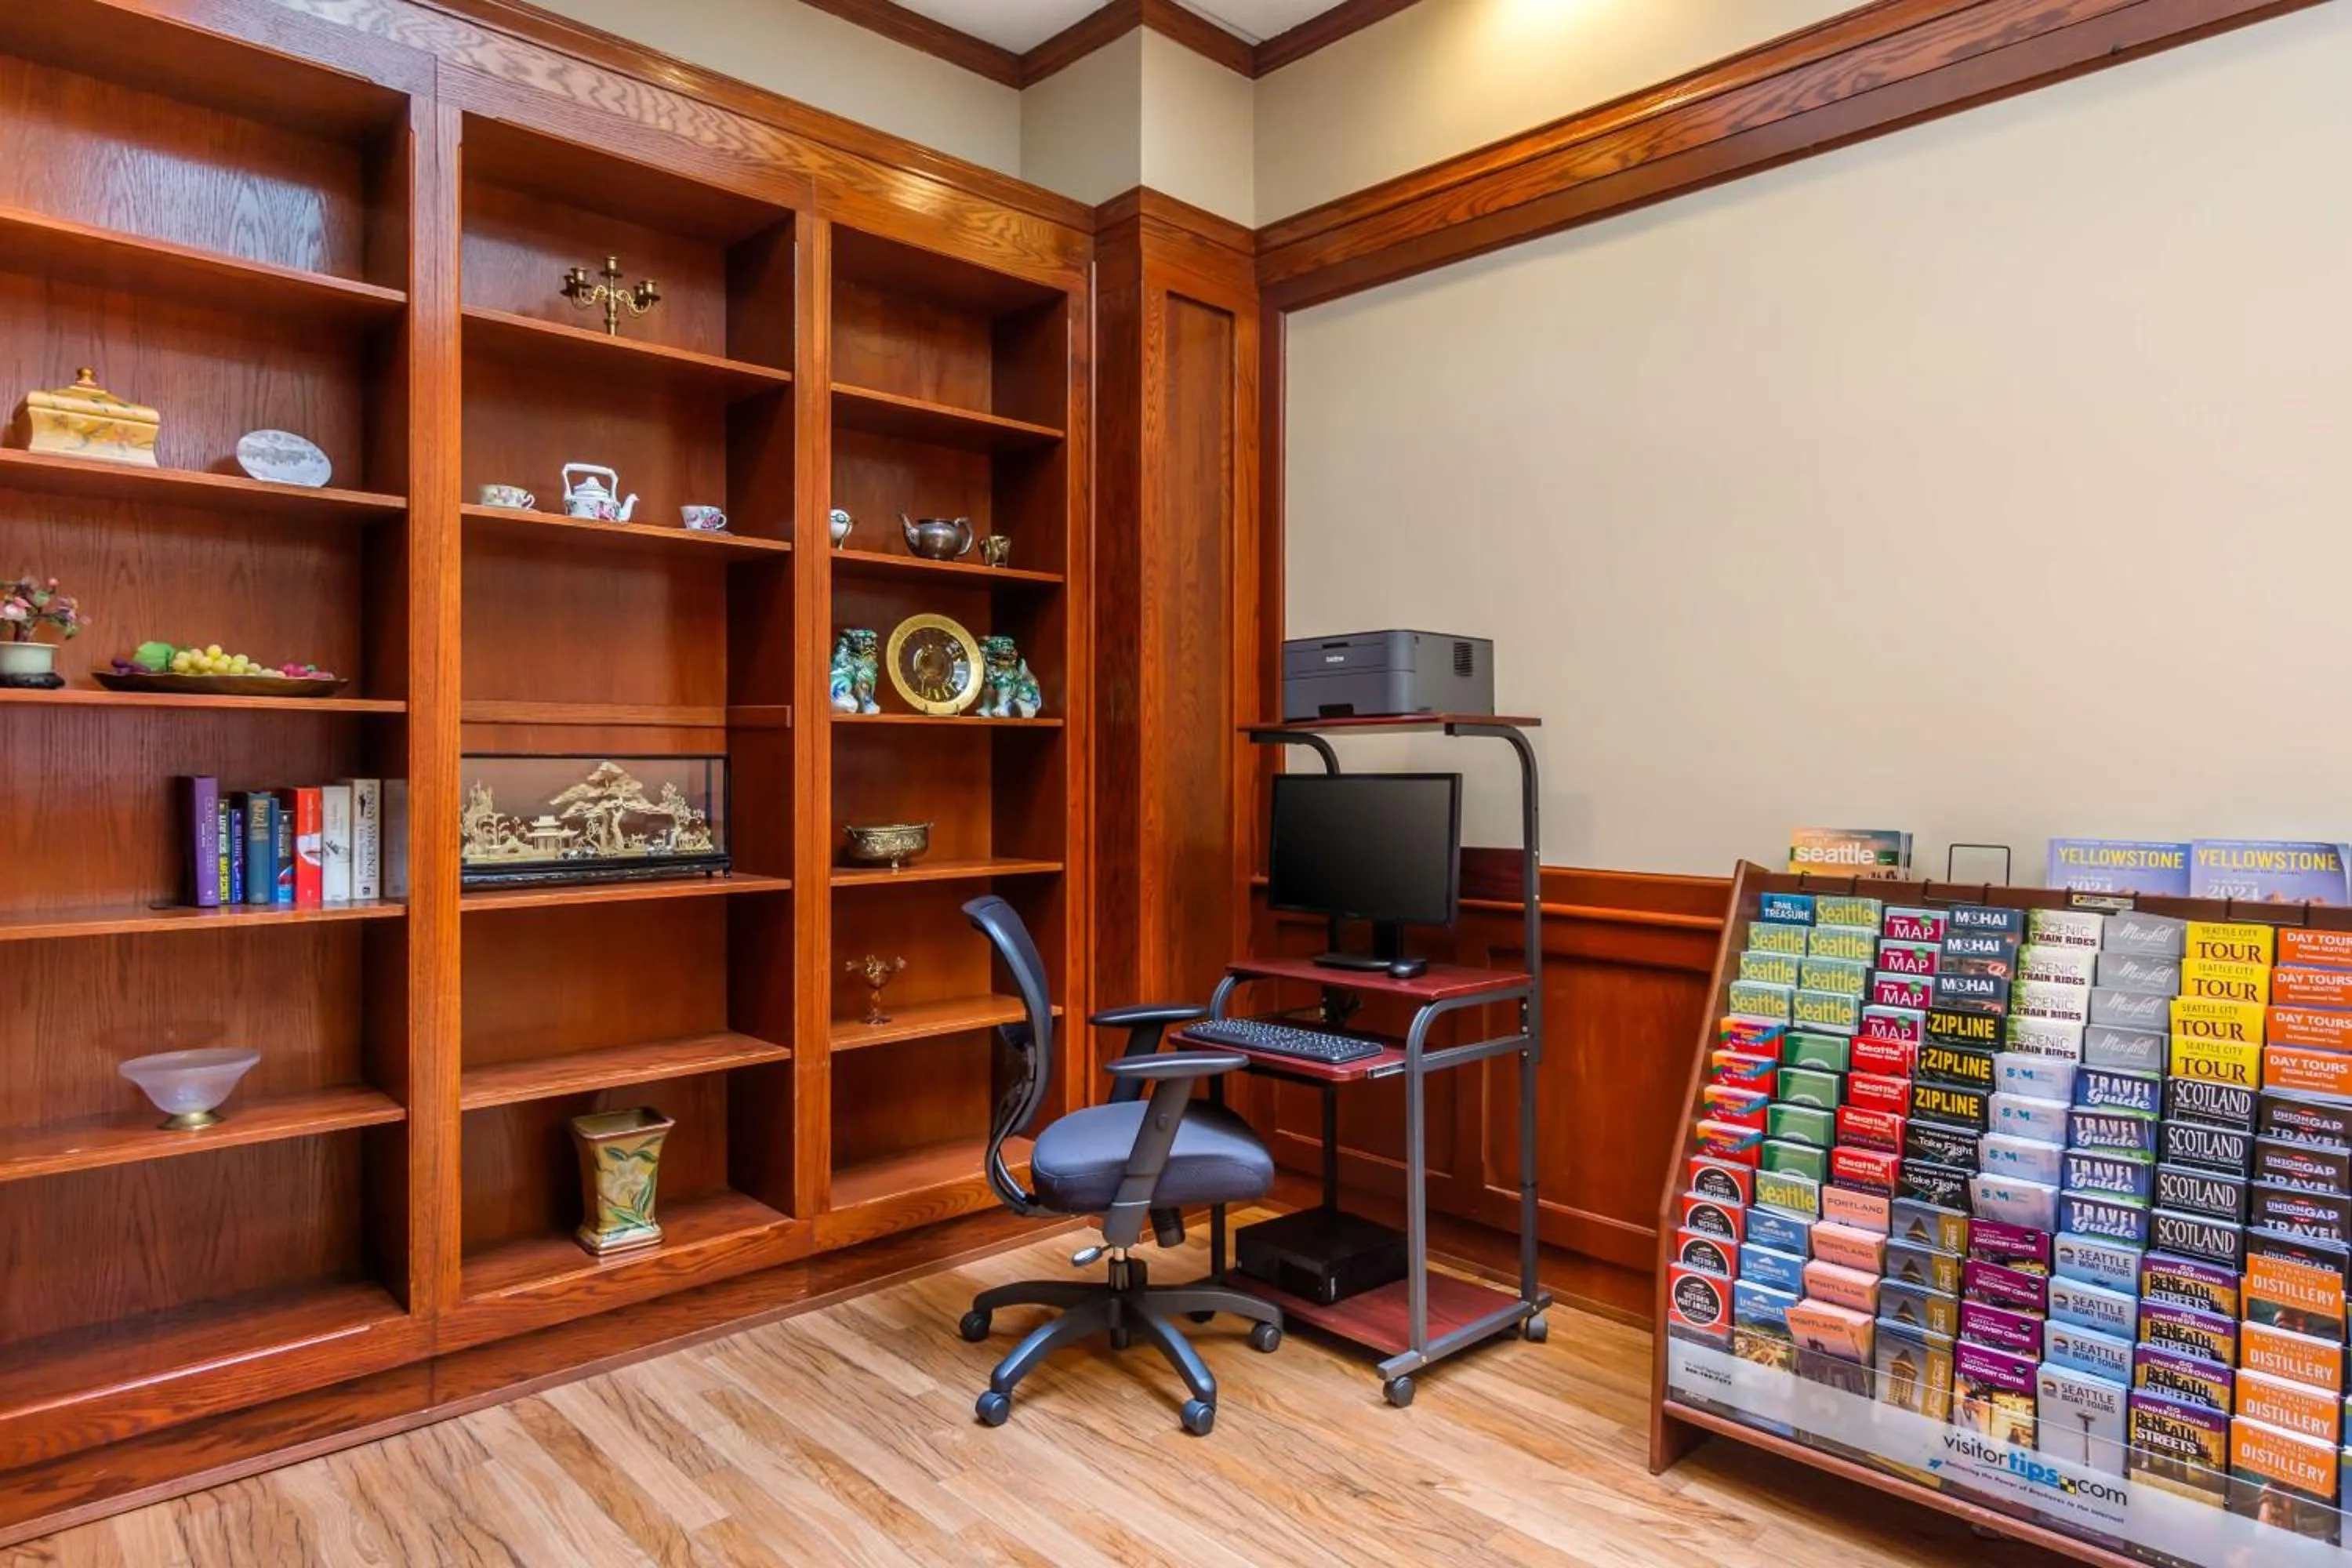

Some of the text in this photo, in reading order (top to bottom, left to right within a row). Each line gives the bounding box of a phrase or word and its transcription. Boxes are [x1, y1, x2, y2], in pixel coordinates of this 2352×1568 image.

[1795, 843, 1875, 865] seattle
[2058, 847, 2186, 869] YELLOWSTONE
[2198, 848, 2339, 872] YELLOWSTONE
[1764, 908, 1810, 920] TREASURE
[1817, 902, 1873, 924] Seattle
[1955, 910, 2008, 926] MOHAI
[1749, 927, 1804, 954] Seattle
[1893, 924, 1934, 940] MAP
[2032, 932, 2096, 946] TRAIN RIDES
[2201, 927, 2236, 935] SEATTLE
[2287, 932, 2314, 942] DAY
[1809, 931, 1866, 958] Seattle
[1947, 938, 2000, 952] MOHAI
[2197, 942, 2262, 964] TOUR
[1741, 958, 1795, 983] Seattle
[1888, 956, 1929, 973] MAP
[2198, 963, 2254, 975] SEATTLE CITY
[1802, 965, 1859, 992] Seattle
[1942, 978, 1994, 992] MOHAI
[2020, 972, 2085, 985] TRAIN RIDES
[2277, 973, 2304, 983] DAY
[1883, 989, 1924, 1007] MAP
[2192, 978, 2259, 1002] TOUR
[1730, 991, 1786, 1017] Seattle
[1794, 996, 1852, 1024] Seattle
[2017, 1007, 2082, 1021] TRAIN RIDES
[2182, 1004, 2238, 1015] SEATTLE CITY
[1932, 1014, 1995, 1039] ZIPLINE
[2276, 1013, 2303, 1023] DAY
[1871, 1024, 1911, 1040] MAP
[2177, 1019, 2245, 1041] TOUR
[2012, 1043, 2077, 1059] TRAIN RIDES
[2186, 1041, 2243, 1055] SEATTLE CITY
[1927, 1048, 1991, 1079] ZIPLINE
[2179, 1056, 2248, 1083] TOUR
[2270, 1055, 2349, 1073] DAY TOURS
[2087, 1073, 2151, 1098] TRAVEL
[1915, 1087, 1979, 1117] ZIPLINE
[2086, 1088, 2151, 1109] Guide
[2176, 1080, 2251, 1114] SCOTLAND
[2073, 1116, 2137, 1135] TRAVEL
[1919, 1137, 1973, 1156] Take Flight
[2077, 1130, 2140, 1148] Guide
[2168, 1127, 2244, 1159] SCOTLAND
[2069, 1158, 2132, 1181] TRAVEL
[1907, 1173, 1962, 1192] Take Flight
[2071, 1172, 2135, 1192] Guide
[2159, 1174, 2236, 1207] SCOTLAND
[1756, 1178, 1816, 1211] Seattle
[1827, 1197, 1883, 1214] PORTLAND
[2071, 1201, 2137, 1230] TRAVEL
[2072, 1216, 2137, 1239] Guide
[2158, 1217, 2234, 1254] SCOTLAND
[1817, 1240, 1873, 1258] PORTLAND
[2078, 1249, 2131, 1269] SEATTLE
[2078, 1259, 2131, 1278] BOAT TOURS
[2152, 1265, 2223, 1284] UNDERGROUND
[2252, 1274, 2336, 1306] DISTILLERY
[2072, 1295, 2125, 1317] SEATTLE
[2072, 1306, 2125, 1325] BOAT TOURS
[1790, 1317, 1842, 1332] PORTLAND
[2152, 1312, 2224, 1333] UNDERGROUND
[2072, 1351, 2125, 1372] BOAT TOURS
[2073, 1339, 2126, 1363] SEATTLE
[2149, 1357, 2223, 1383] UNDERGROUND
[2249, 1348, 2332, 1381] DISTILLERY
[2060, 1383, 2114, 1405] SEATTLE
[2060, 1394, 2115, 1414] BOAT TOURS
[2138, 1403, 2209, 1428] UNDERGROUND
[2246, 1398, 2331, 1436] DISTILLERY
[2136, 1427, 2197, 1454] STREETS
[1943, 1433, 2128, 1506] visitortips.com
[2241, 1443, 2327, 1484] DISTILLERY
